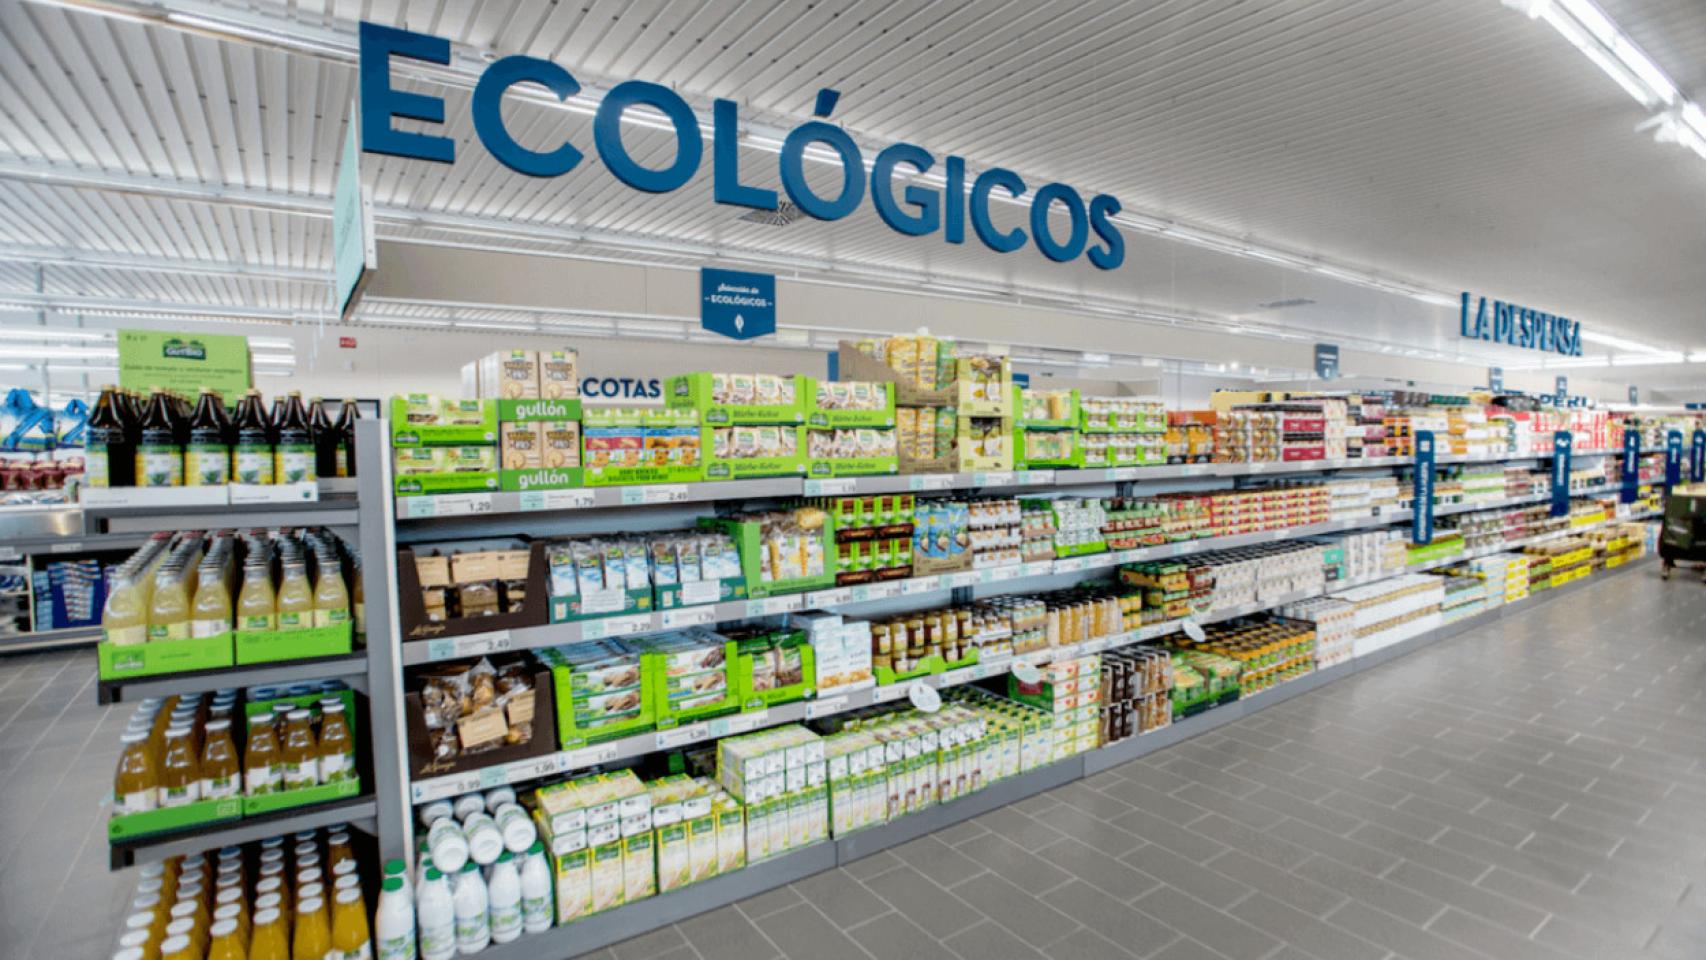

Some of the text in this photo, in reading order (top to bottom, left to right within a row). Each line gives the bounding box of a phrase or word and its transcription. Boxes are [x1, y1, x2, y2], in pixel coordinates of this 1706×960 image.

[359, 21, 1126, 270] ECOLÓGICOS
[1461, 291, 1584, 357] LA DESPENSA
[577, 376, 662, 398] COTAS
[516, 400, 567, 418] gullón
[518, 469, 569, 490] gullón
